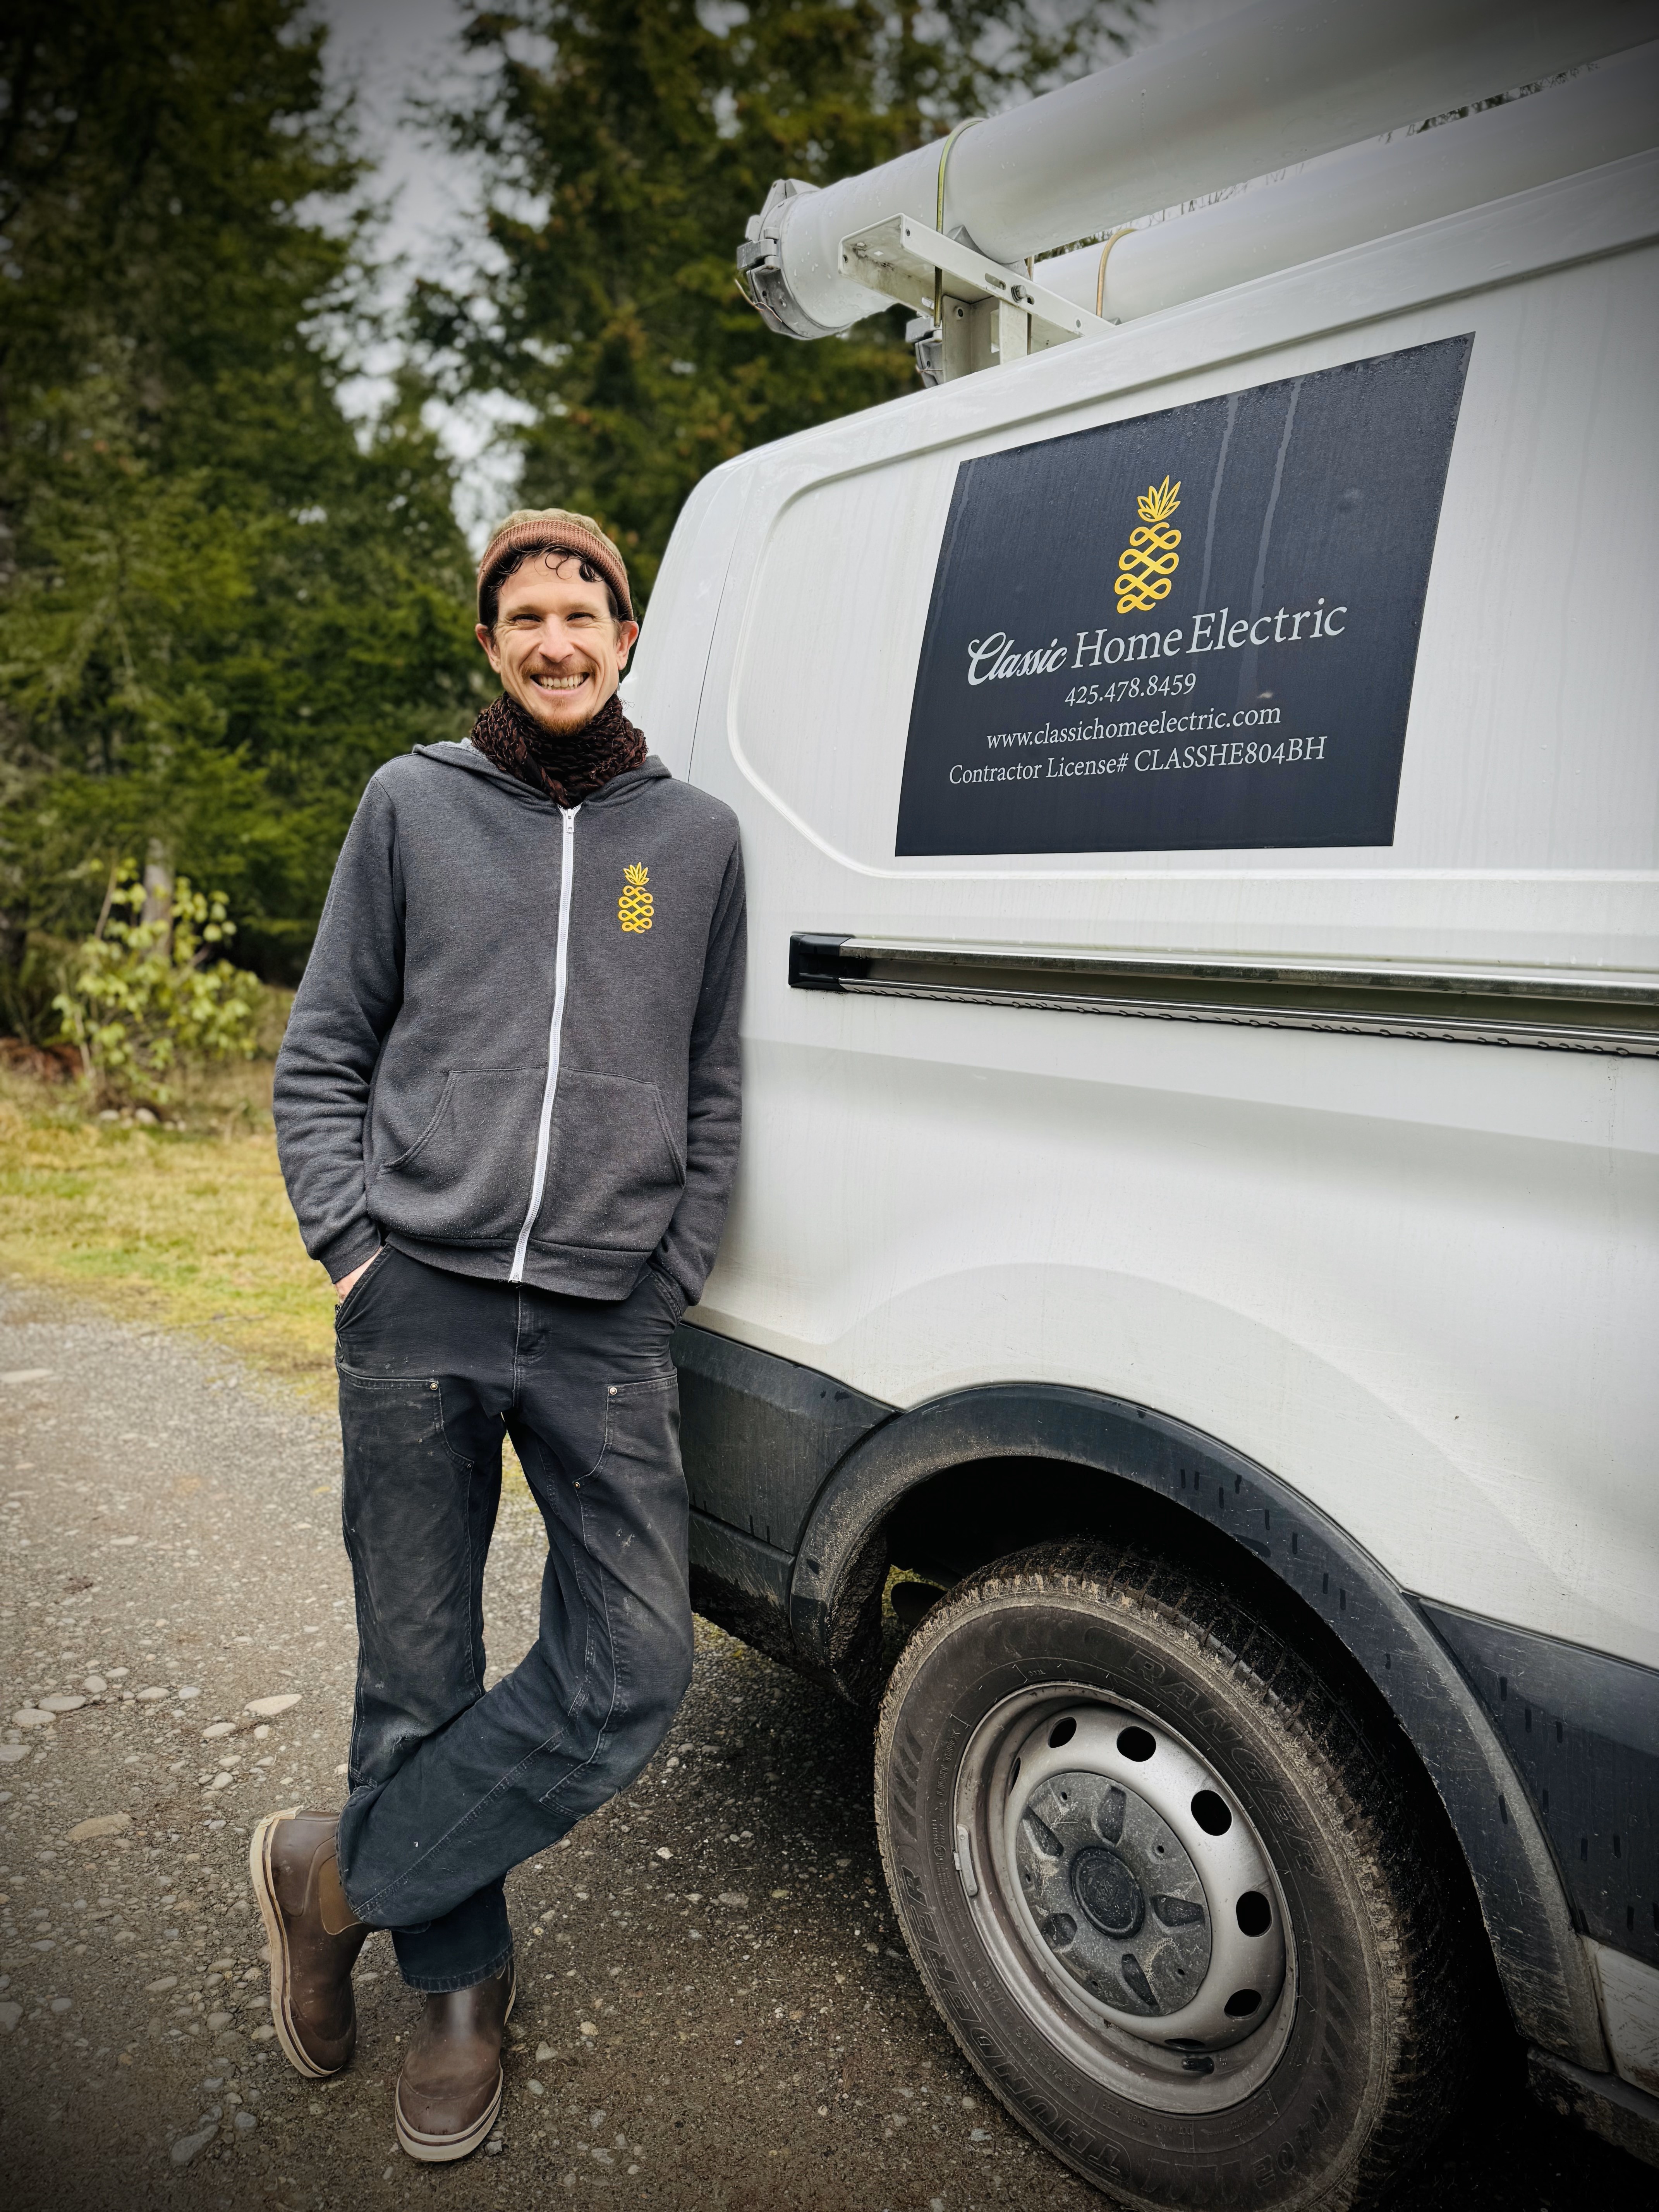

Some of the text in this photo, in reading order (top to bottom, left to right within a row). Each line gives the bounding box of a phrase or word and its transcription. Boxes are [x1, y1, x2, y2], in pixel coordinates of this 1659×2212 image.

[967, 597, 1348, 686] Classic Home Electric
[1064, 673, 1197, 707] 425.478.8459
[949, 735, 1328, 784] Contractor License# CLASSHE804BH
[986, 707, 1281, 749] www.classichomeelectric.com
[936, 1765, 948, 1796] LIGHT
[943, 1729, 961, 1762] TRUCK
[1124, 1649, 1326, 1879] RANGER
[901, 1863, 1121, 2176] THUNDERER
